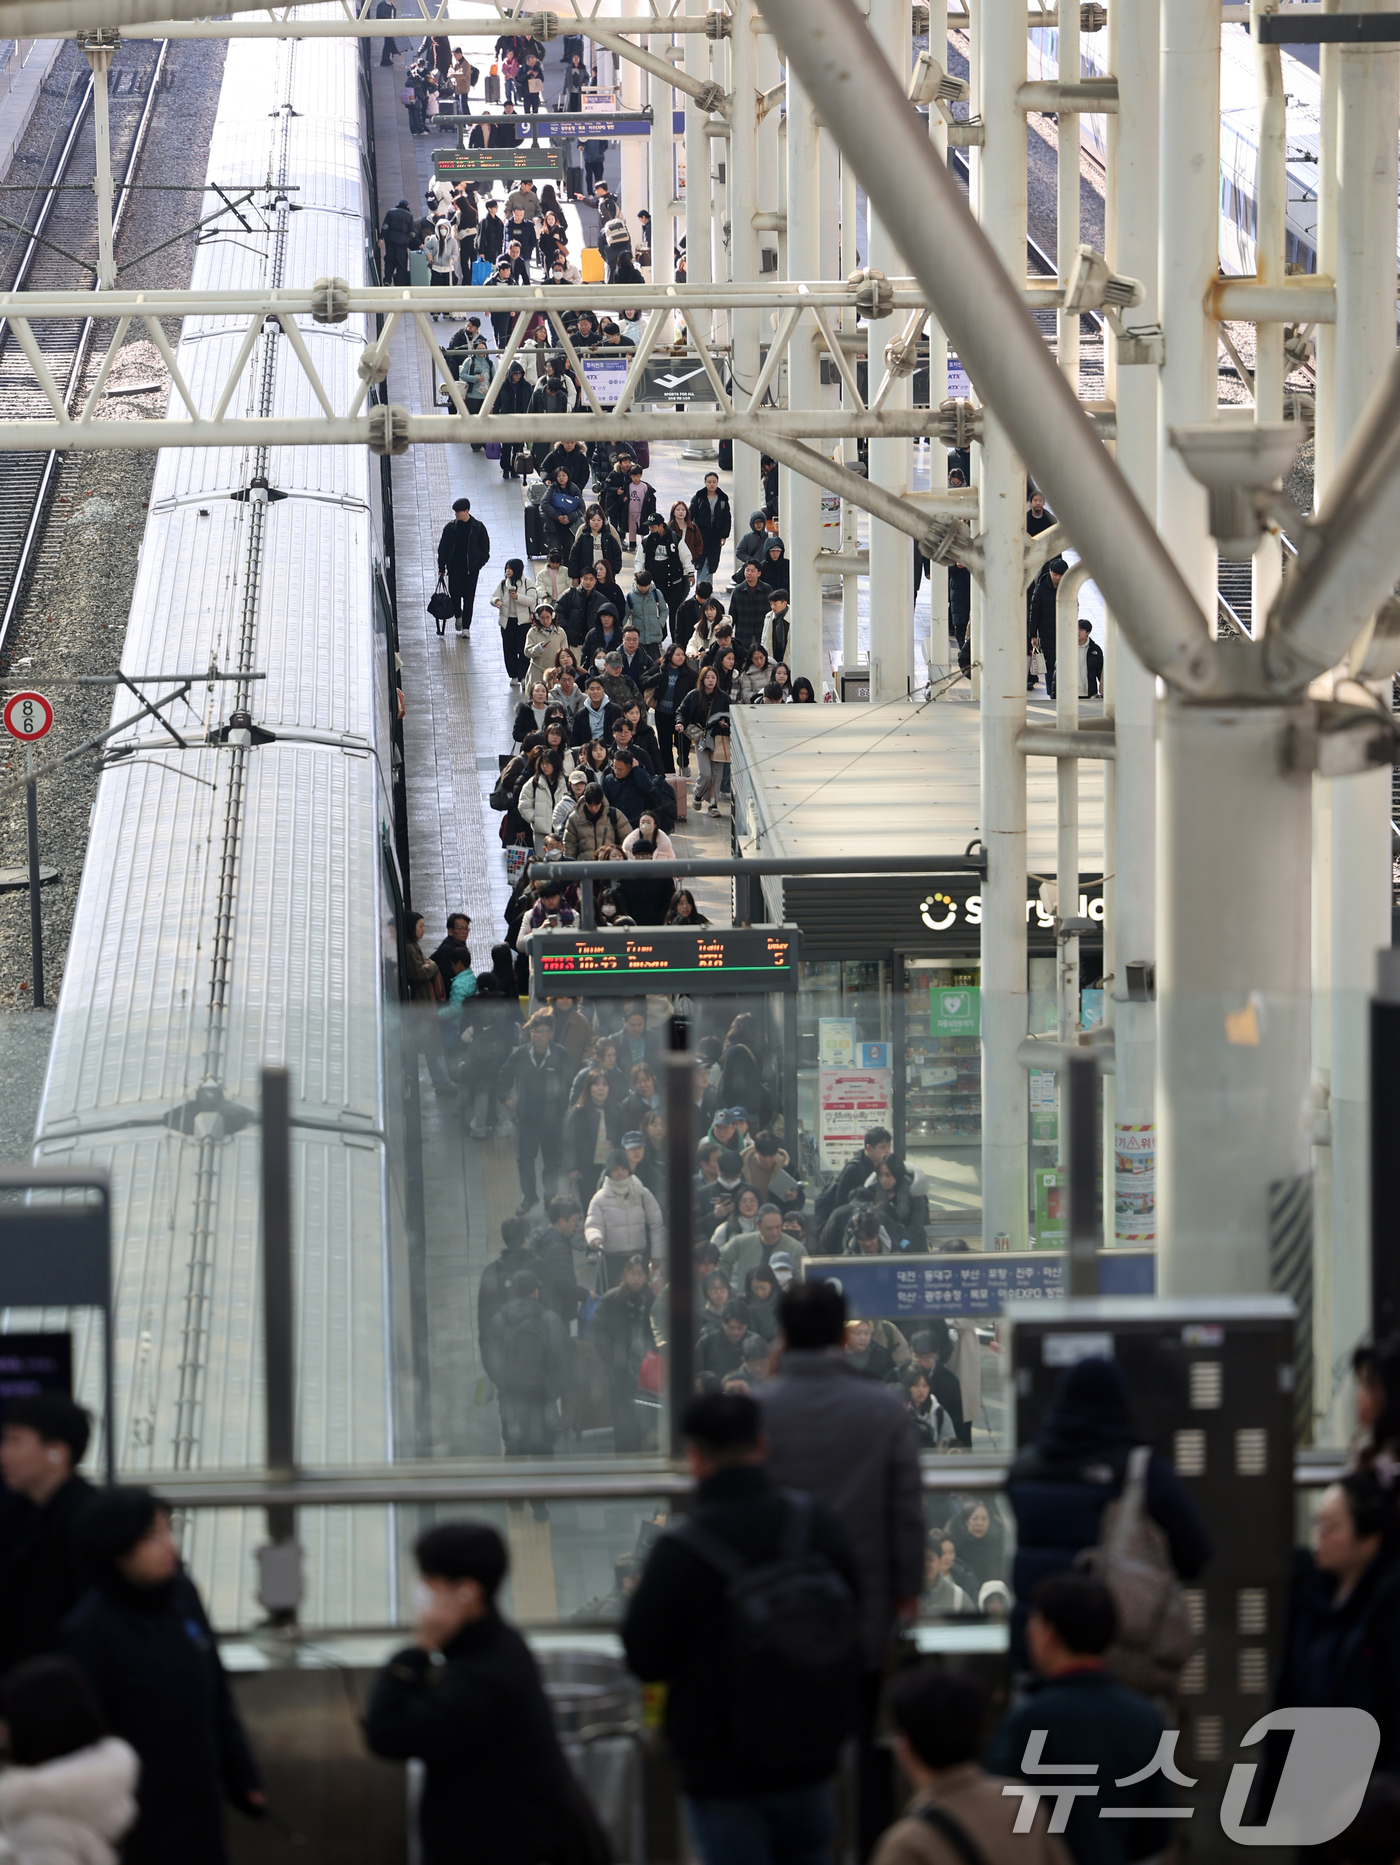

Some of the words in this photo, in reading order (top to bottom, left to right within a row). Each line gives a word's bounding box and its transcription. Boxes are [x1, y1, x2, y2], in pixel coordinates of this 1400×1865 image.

[521, 122, 531, 134] 9
[670, 543, 676, 552] C
[23, 701, 33, 716] 8
[24, 718, 33, 733] 6
[897, 1270, 916, 1282] 대전
[924, 1270, 952, 1282] 동대구
[960, 1269, 980, 1280] 부산
[988, 1268, 1007, 1280] 포항
[1015, 1267, 1034, 1279] 진주
[924, 1290, 962, 1302] 광주송정
[970, 1289, 988, 1299] 목포
